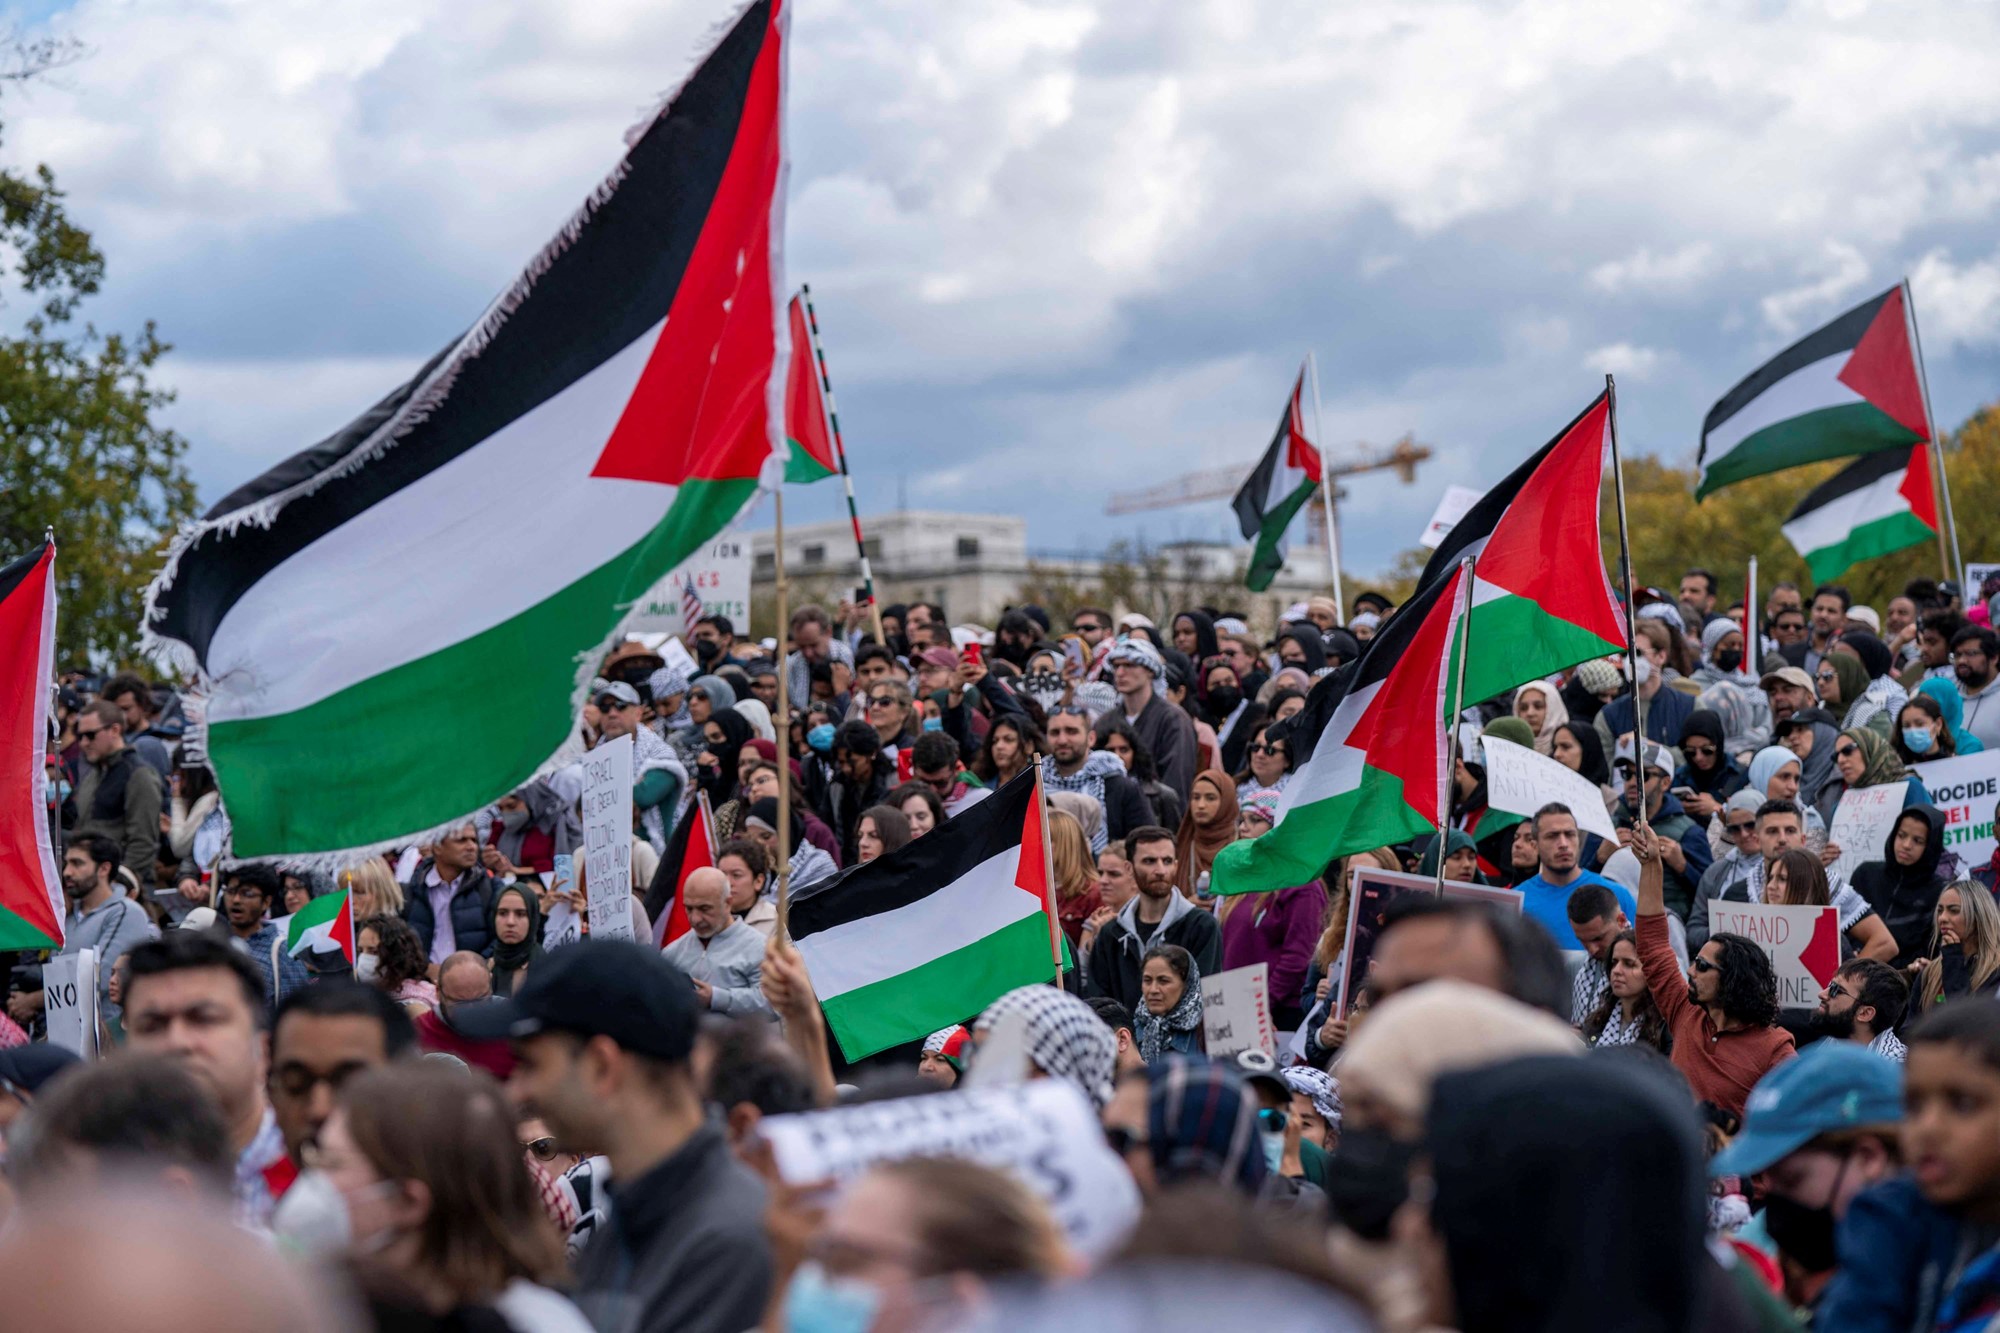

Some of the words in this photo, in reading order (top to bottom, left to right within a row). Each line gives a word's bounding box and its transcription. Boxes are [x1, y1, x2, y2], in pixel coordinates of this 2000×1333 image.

[1928, 778, 1997, 804] NOCIDE
[1944, 821, 1995, 846] STINE
[1715, 912, 1726, 933] I
[1731, 914, 1790, 945] STAND
[47, 982, 77, 1011] NO
